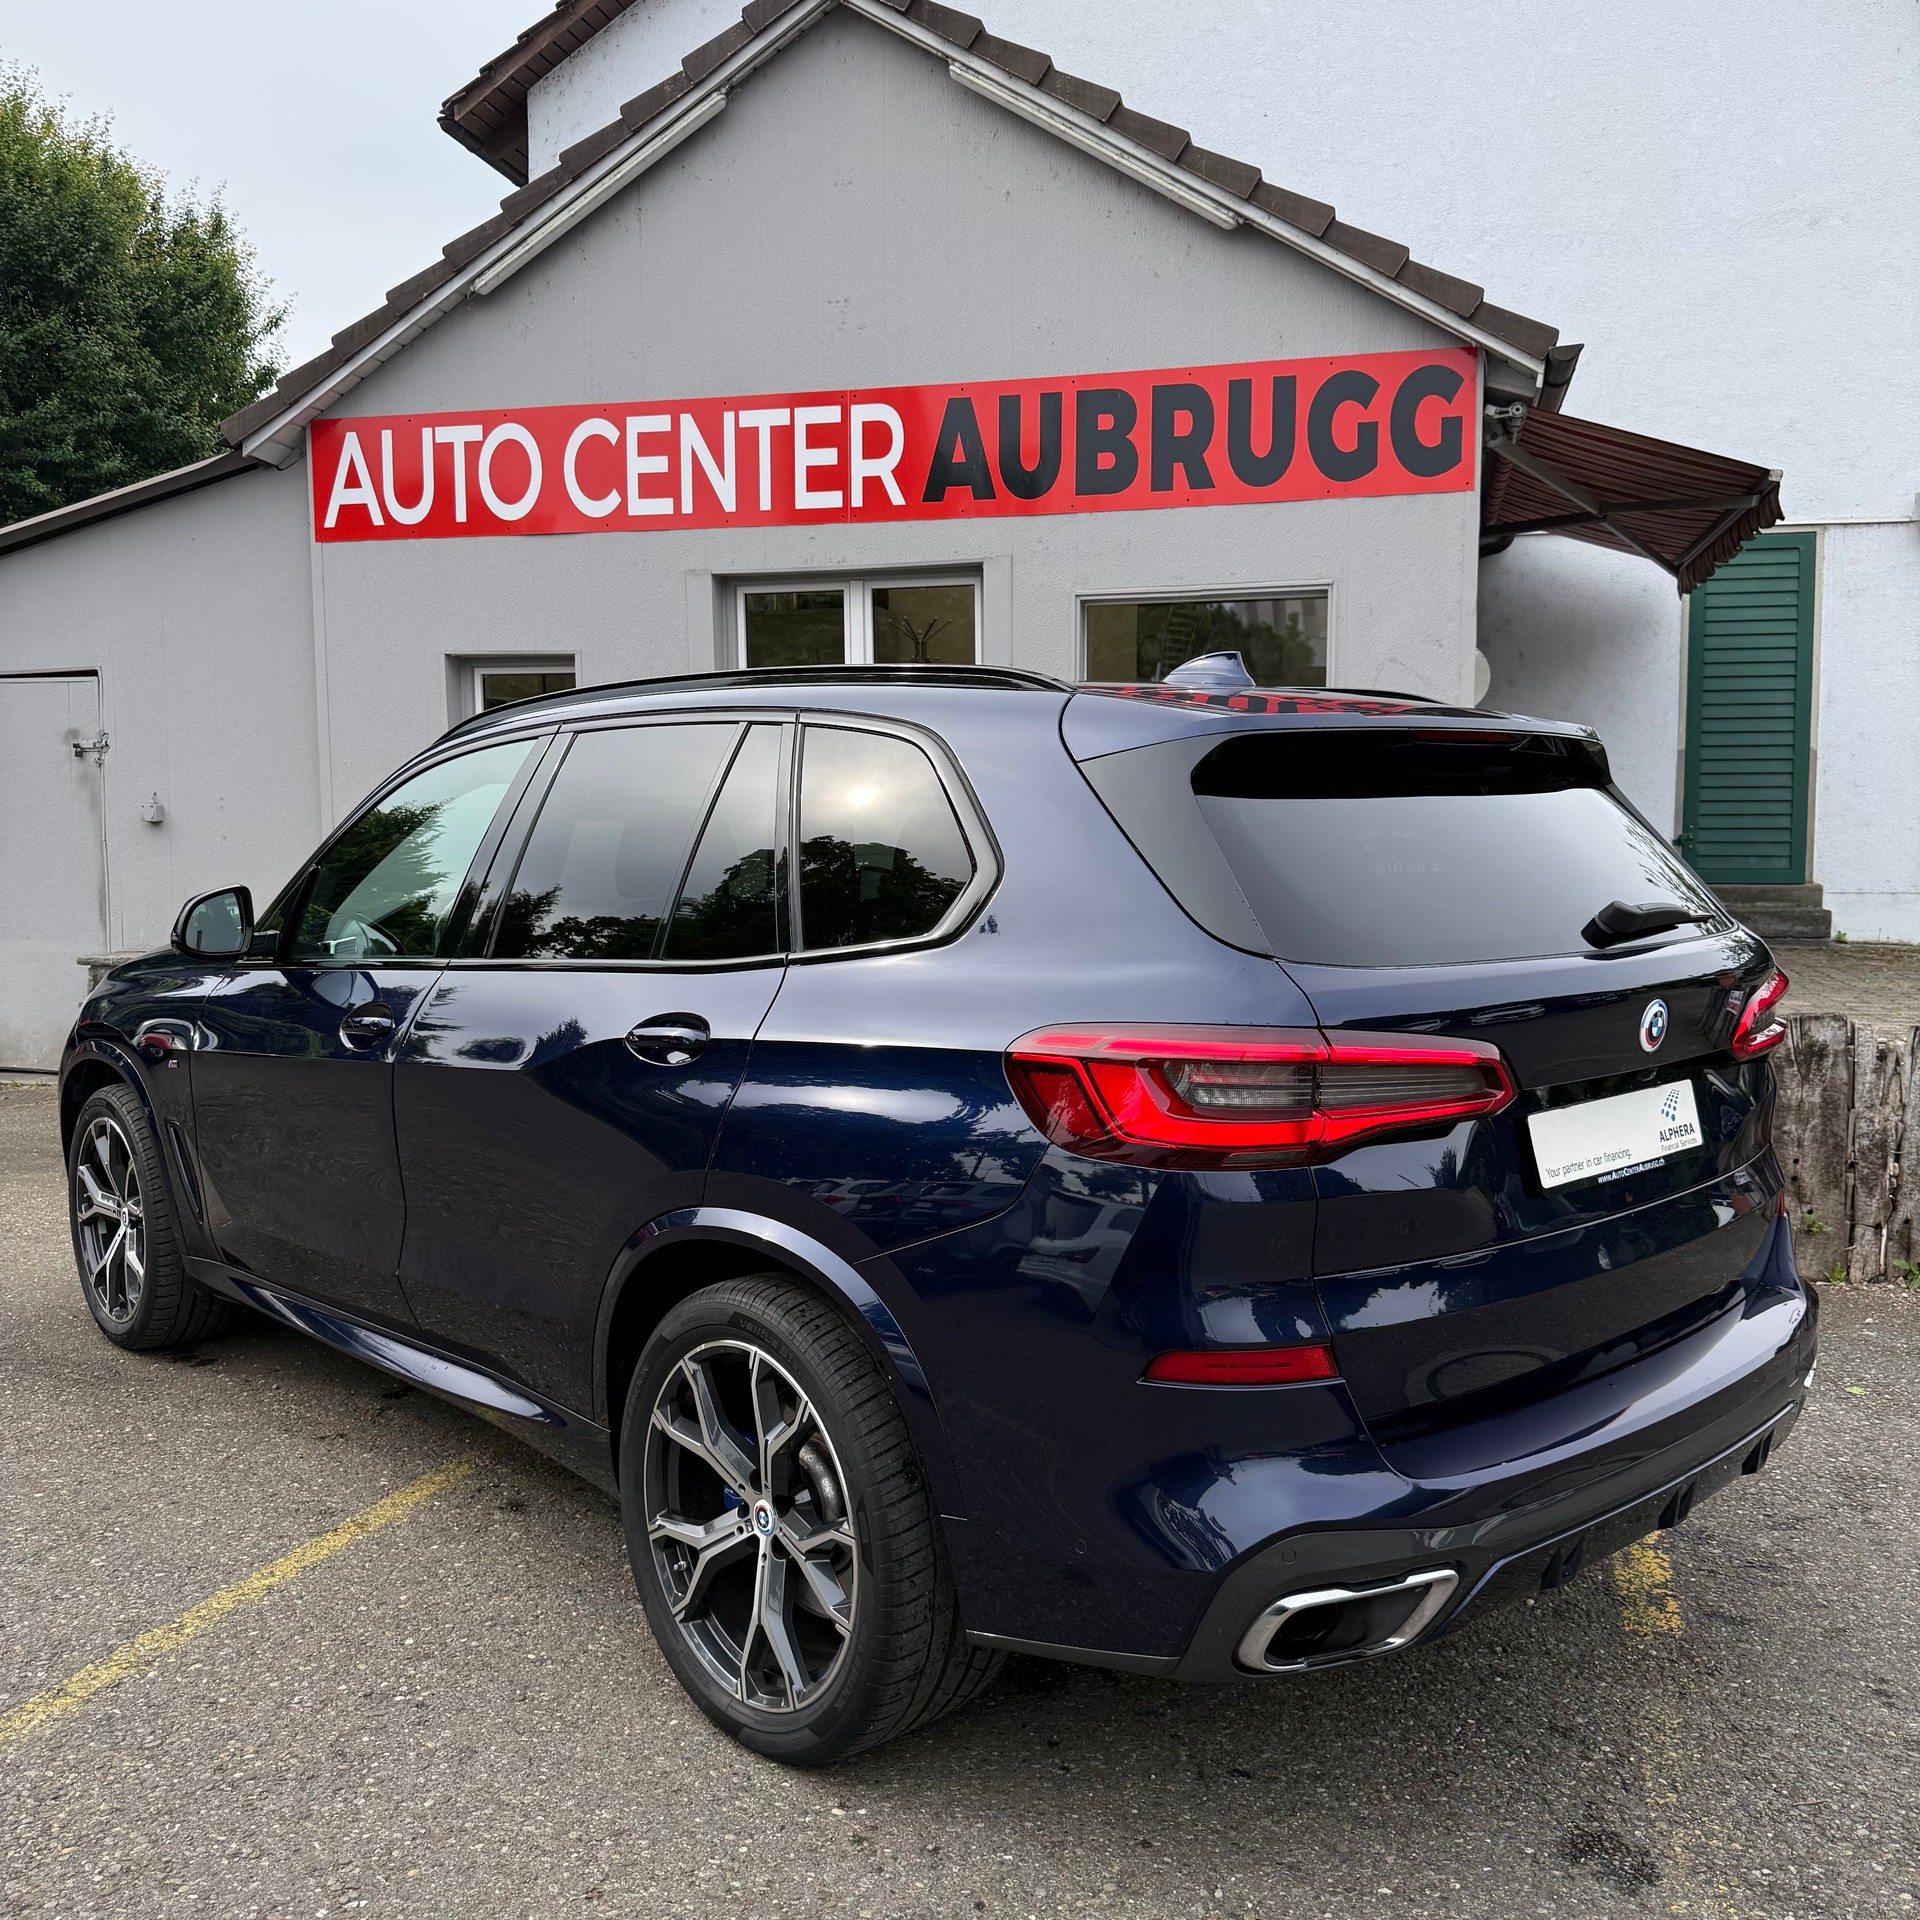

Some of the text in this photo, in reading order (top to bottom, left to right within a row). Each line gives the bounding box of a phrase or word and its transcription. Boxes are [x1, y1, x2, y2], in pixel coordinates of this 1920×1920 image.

[324, 364, 1465, 529] AUTO CENTER AUBRUGG
[1659, 1123, 1695, 1143] ALPHERA
[1661, 1136, 1698, 1153] Financial Services
[1546, 1148, 1633, 1179] Your partner in car financing.
